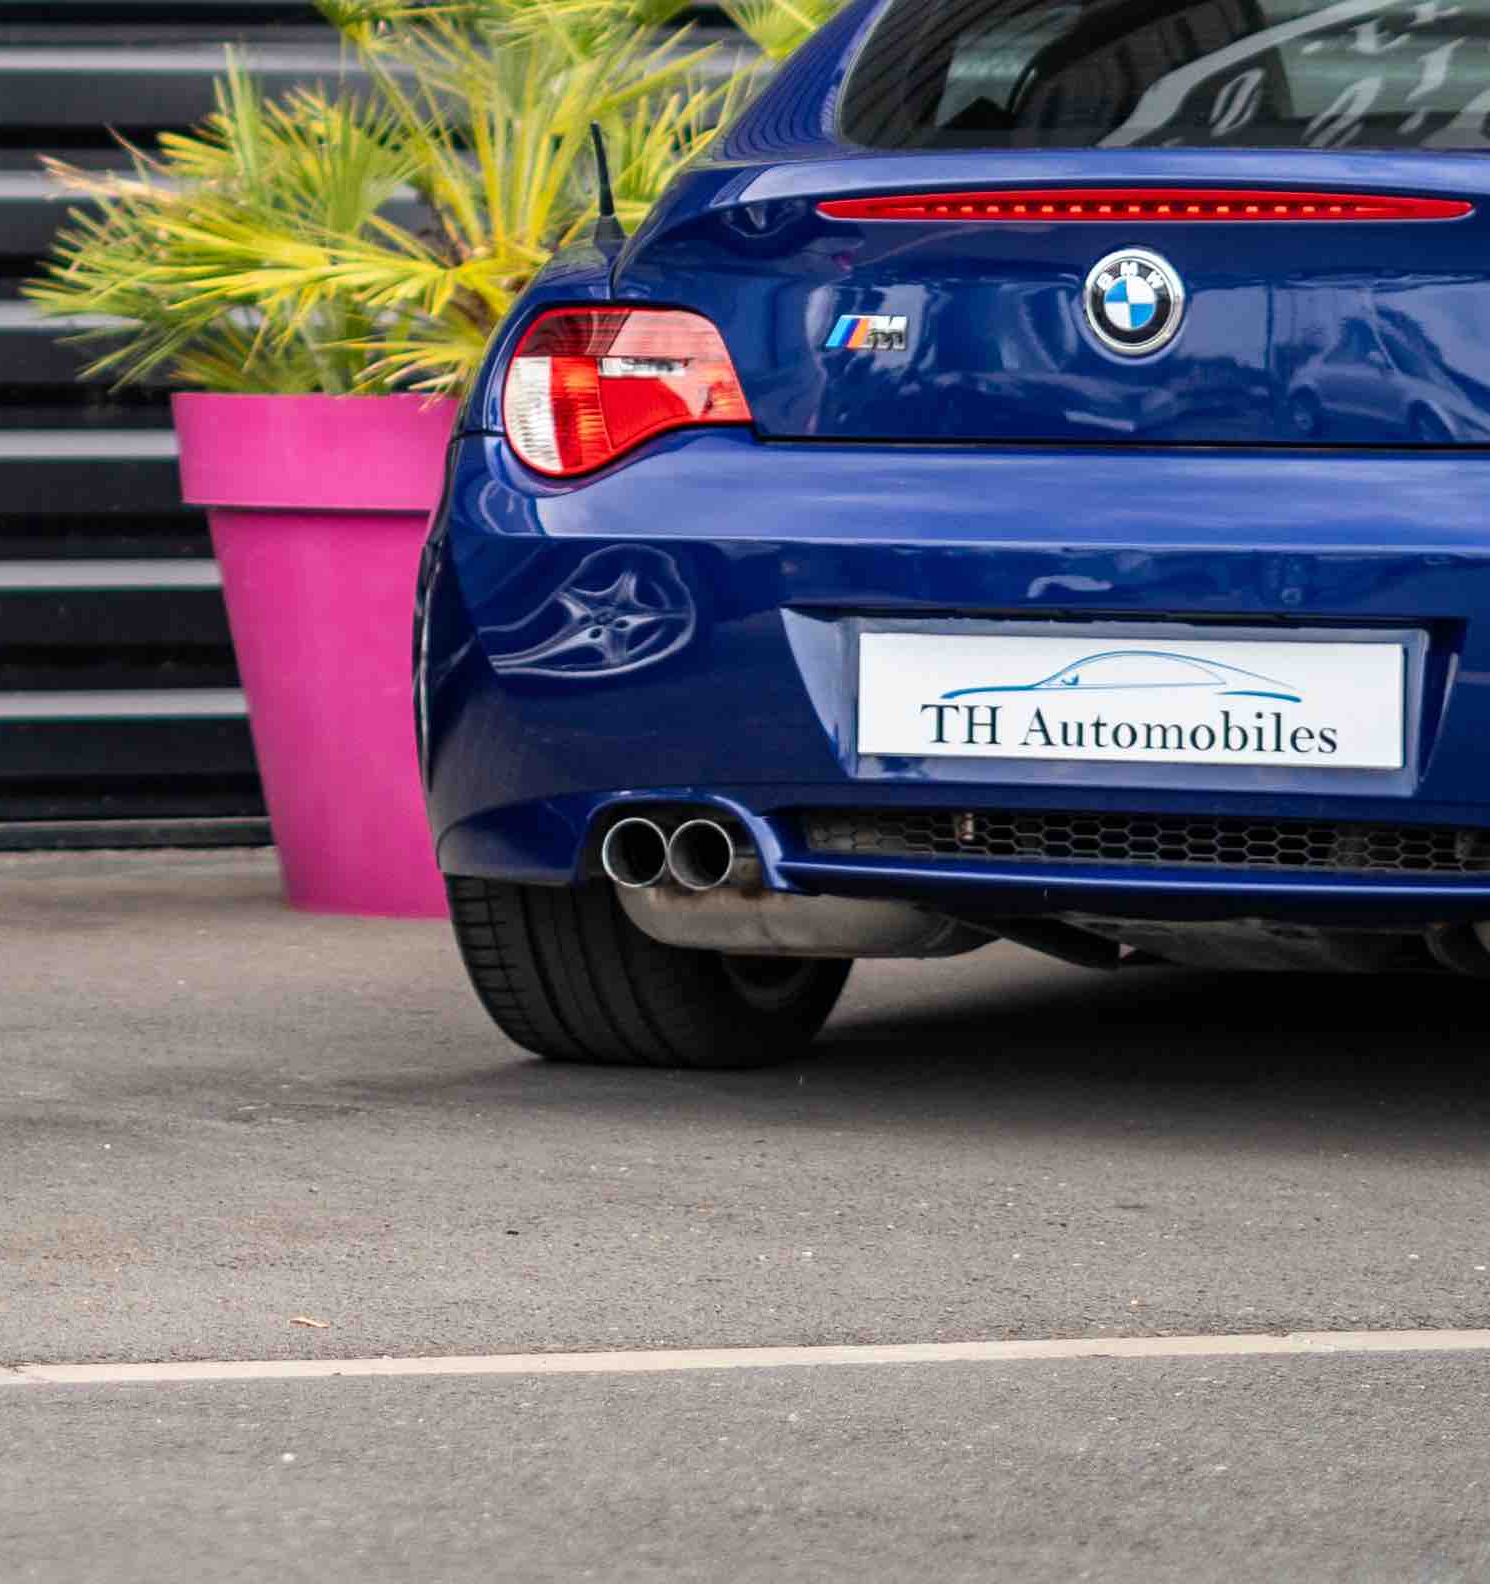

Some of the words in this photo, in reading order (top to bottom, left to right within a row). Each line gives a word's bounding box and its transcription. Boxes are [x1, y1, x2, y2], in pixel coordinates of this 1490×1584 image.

[1097, 261, 1164, 289] BMW
[920, 703, 1004, 747] TH
[1020, 707, 1339, 754] Automobiles
